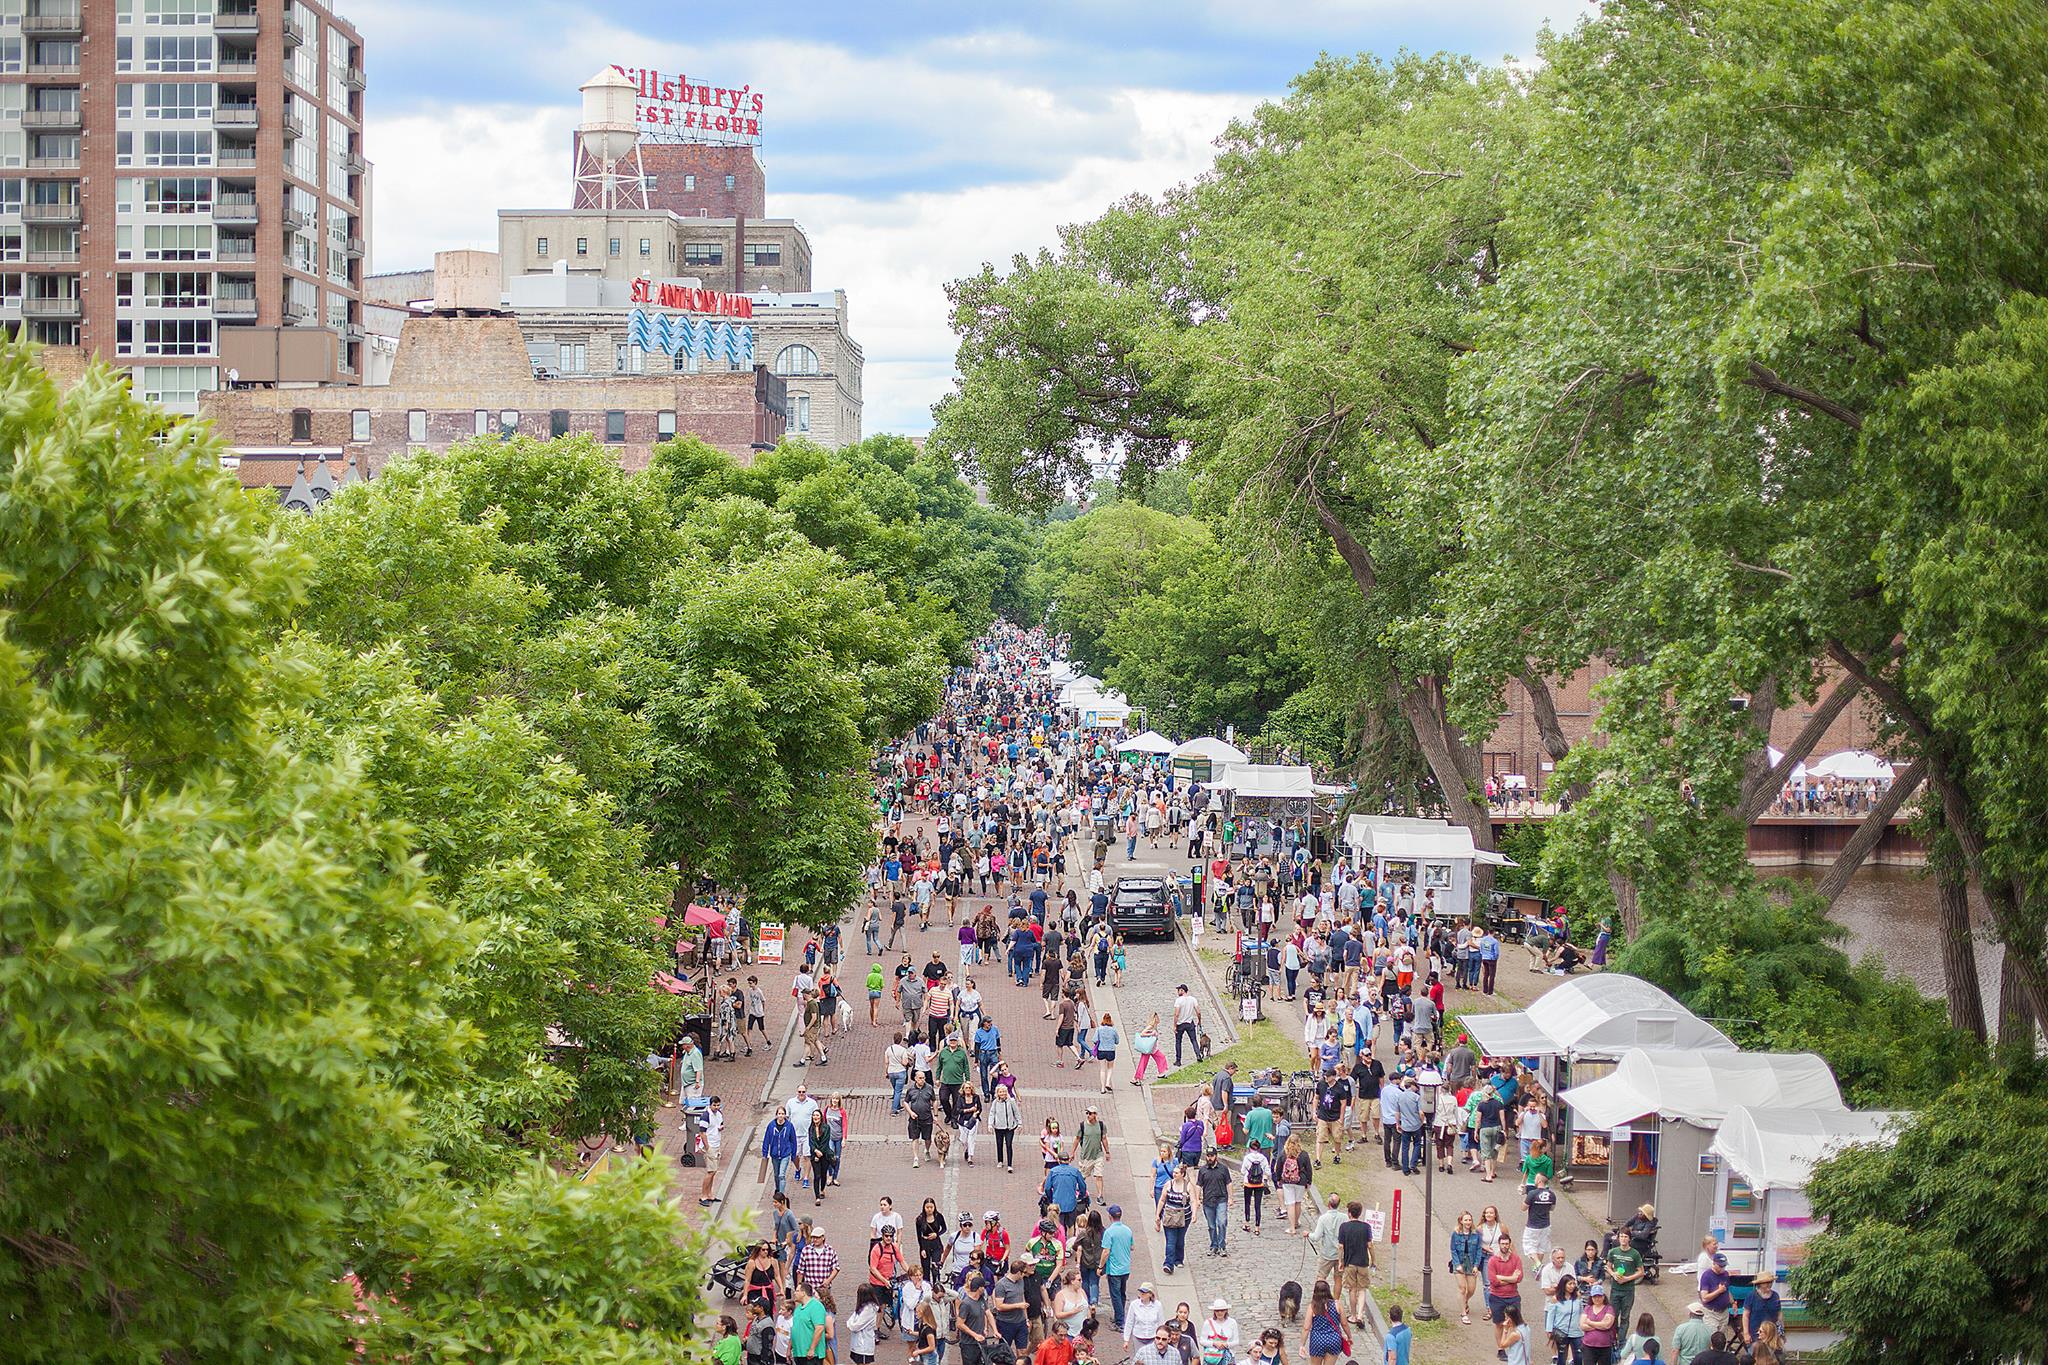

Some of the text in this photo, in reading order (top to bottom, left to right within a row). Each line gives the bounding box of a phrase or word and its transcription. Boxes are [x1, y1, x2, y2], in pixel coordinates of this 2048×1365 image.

[609, 64, 763, 114] illsbury's
[635, 104, 760, 136] EST FLOUR
[653, 282, 720, 313] ANTHONY
[719, 291, 752, 319] MAIN
